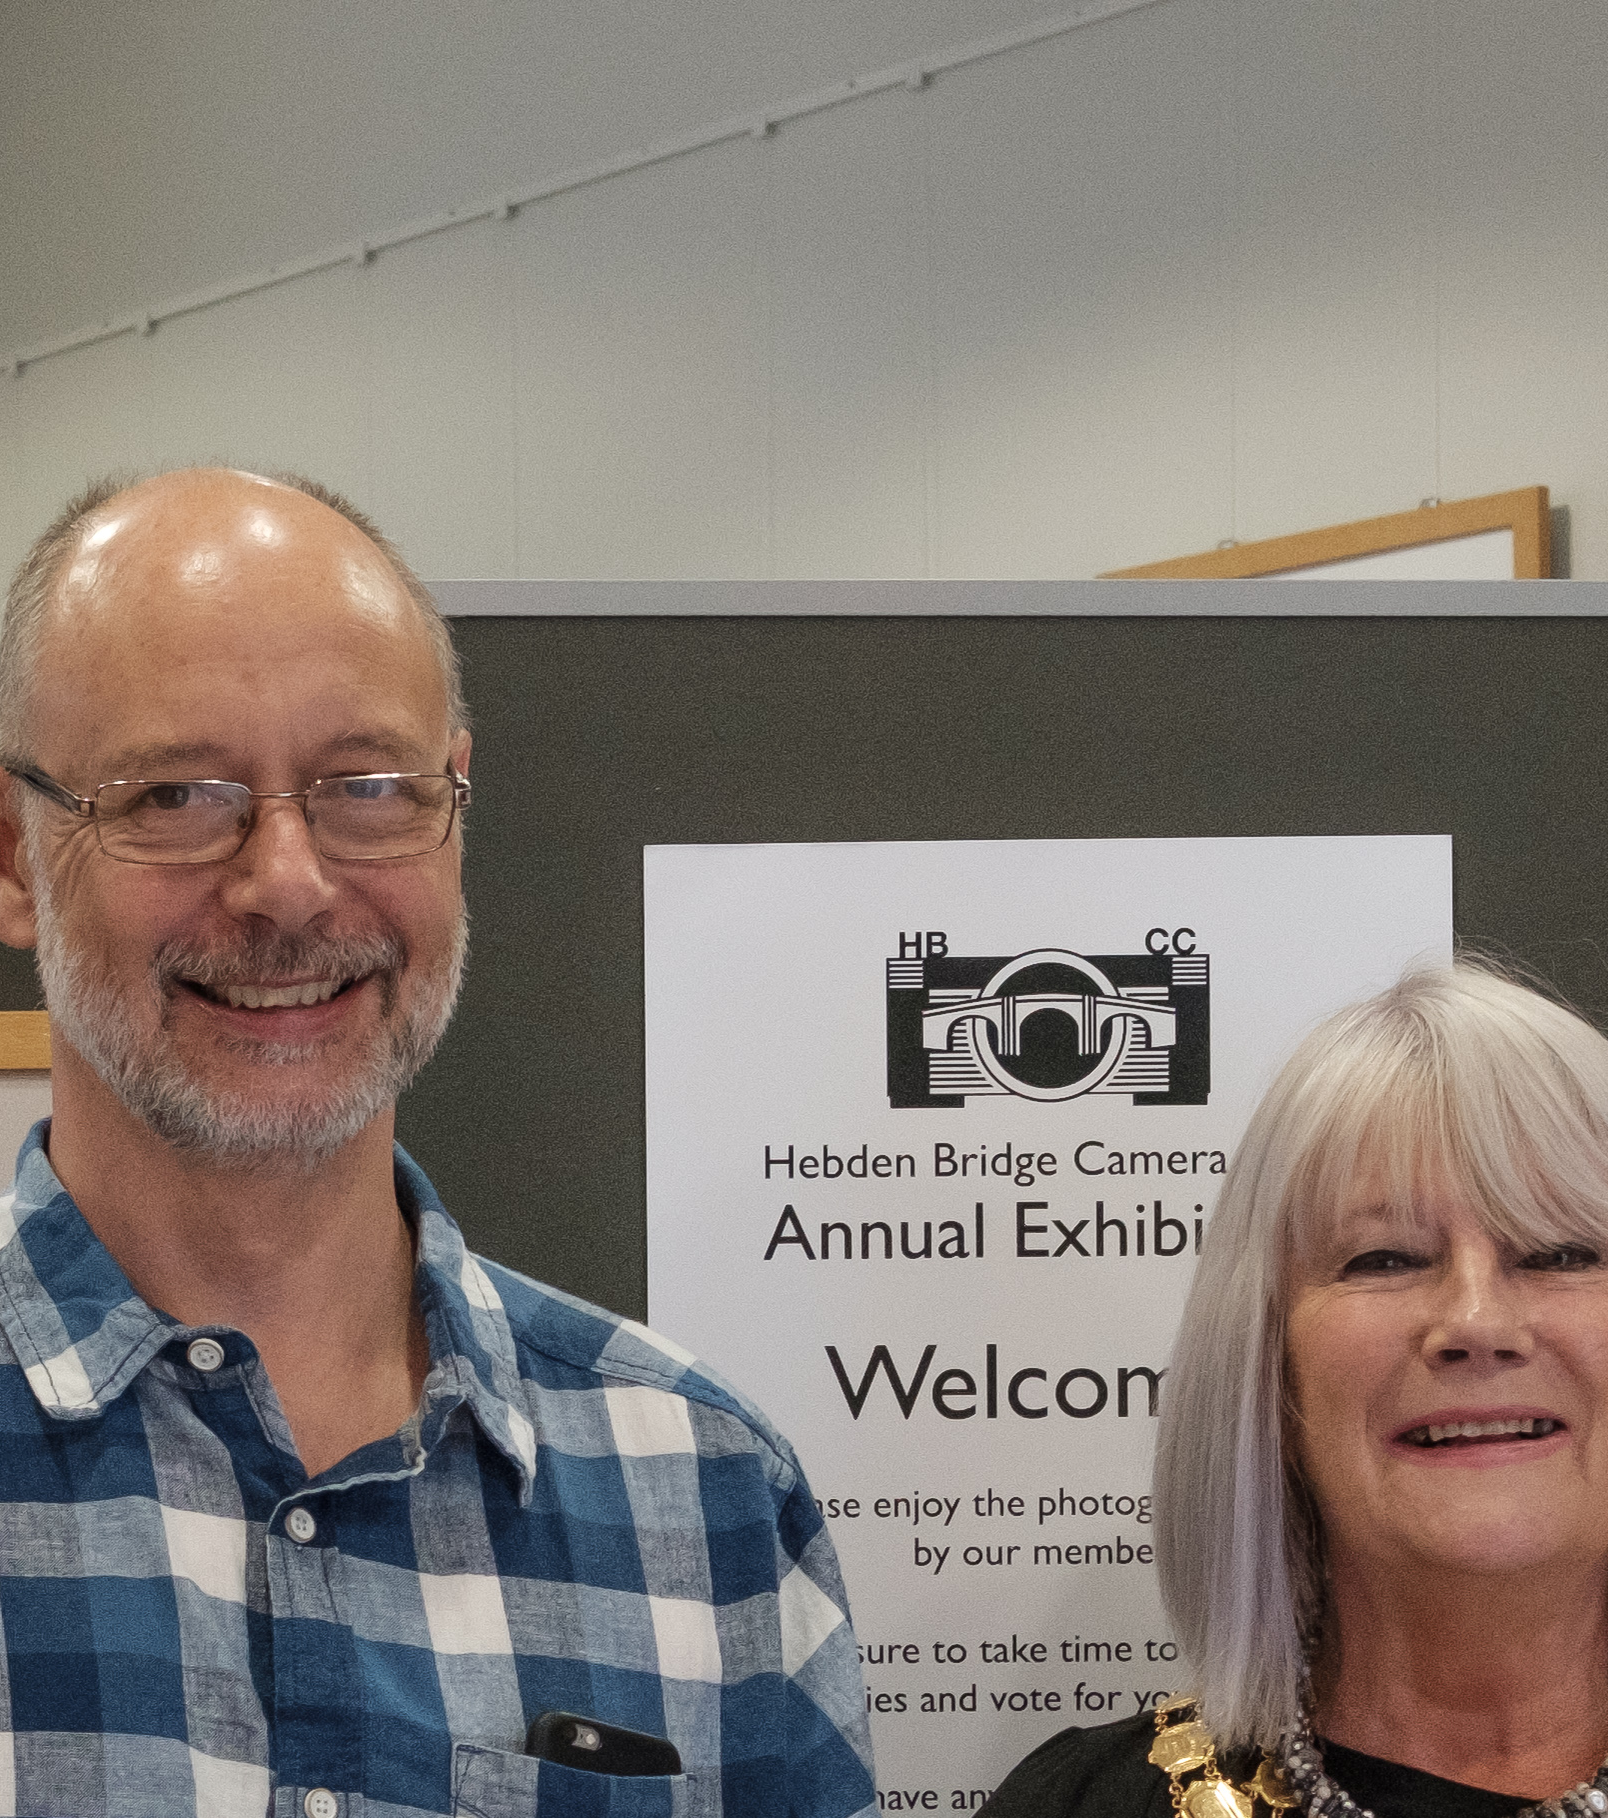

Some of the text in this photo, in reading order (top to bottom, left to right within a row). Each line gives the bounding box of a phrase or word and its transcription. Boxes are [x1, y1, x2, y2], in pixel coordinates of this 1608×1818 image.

[899, 927, 1197, 958] HB CC
[764, 1140, 1227, 1187] Hebden Bridge Camera
[763, 1200, 1204, 1261] Annual Exhibi
[873, 1490, 961, 1527] enjoy
[971, 1487, 1025, 1517] the
[914, 1535, 1154, 1575] by our membe
[932, 1641, 967, 1664] to
[978, 1633, 1048, 1664] take
[1059, 1635, 1132, 1663] time
[1143, 1639, 1179, 1662] to
[920, 1683, 977, 1713] and
[989, 1688, 1062, 1712] vote
[1073, 1681, 1123, 1712] for
[1132, 1690, 1178, 1716] yo
